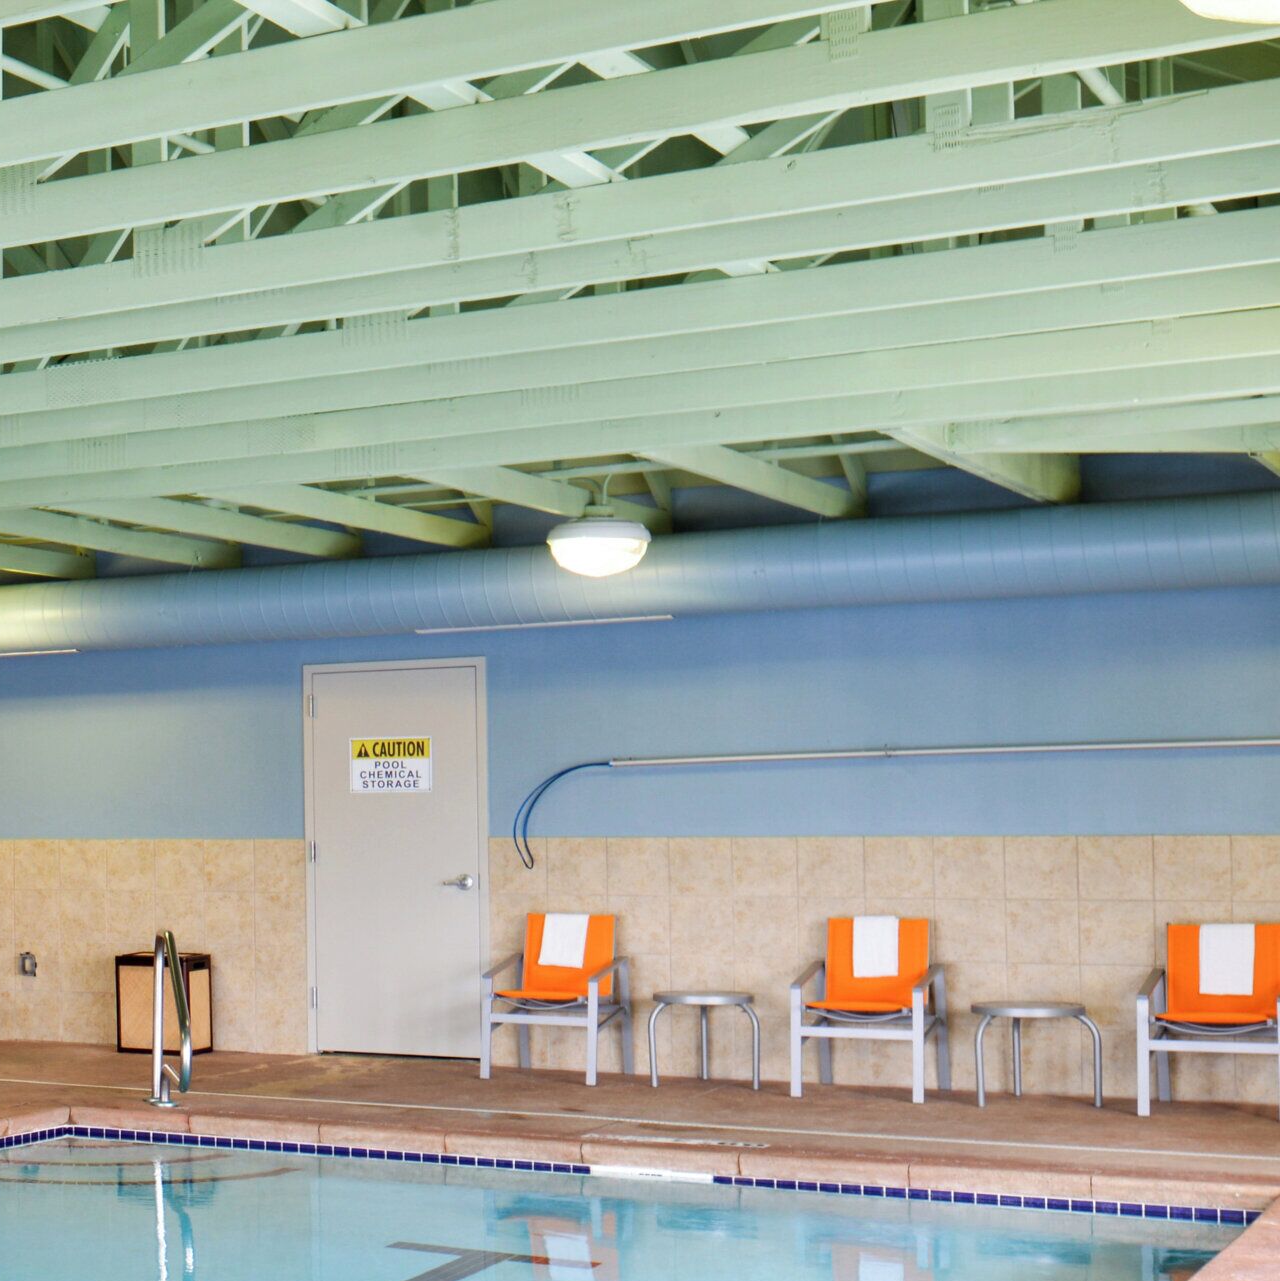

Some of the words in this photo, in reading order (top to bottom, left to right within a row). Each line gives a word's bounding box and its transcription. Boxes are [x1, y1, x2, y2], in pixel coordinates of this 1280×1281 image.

[372, 741, 425, 757] CAUTION
[374, 760, 407, 770] POOL
[360, 770, 422, 779] CHEMICAL
[362, 780, 420, 789] STORAGE
